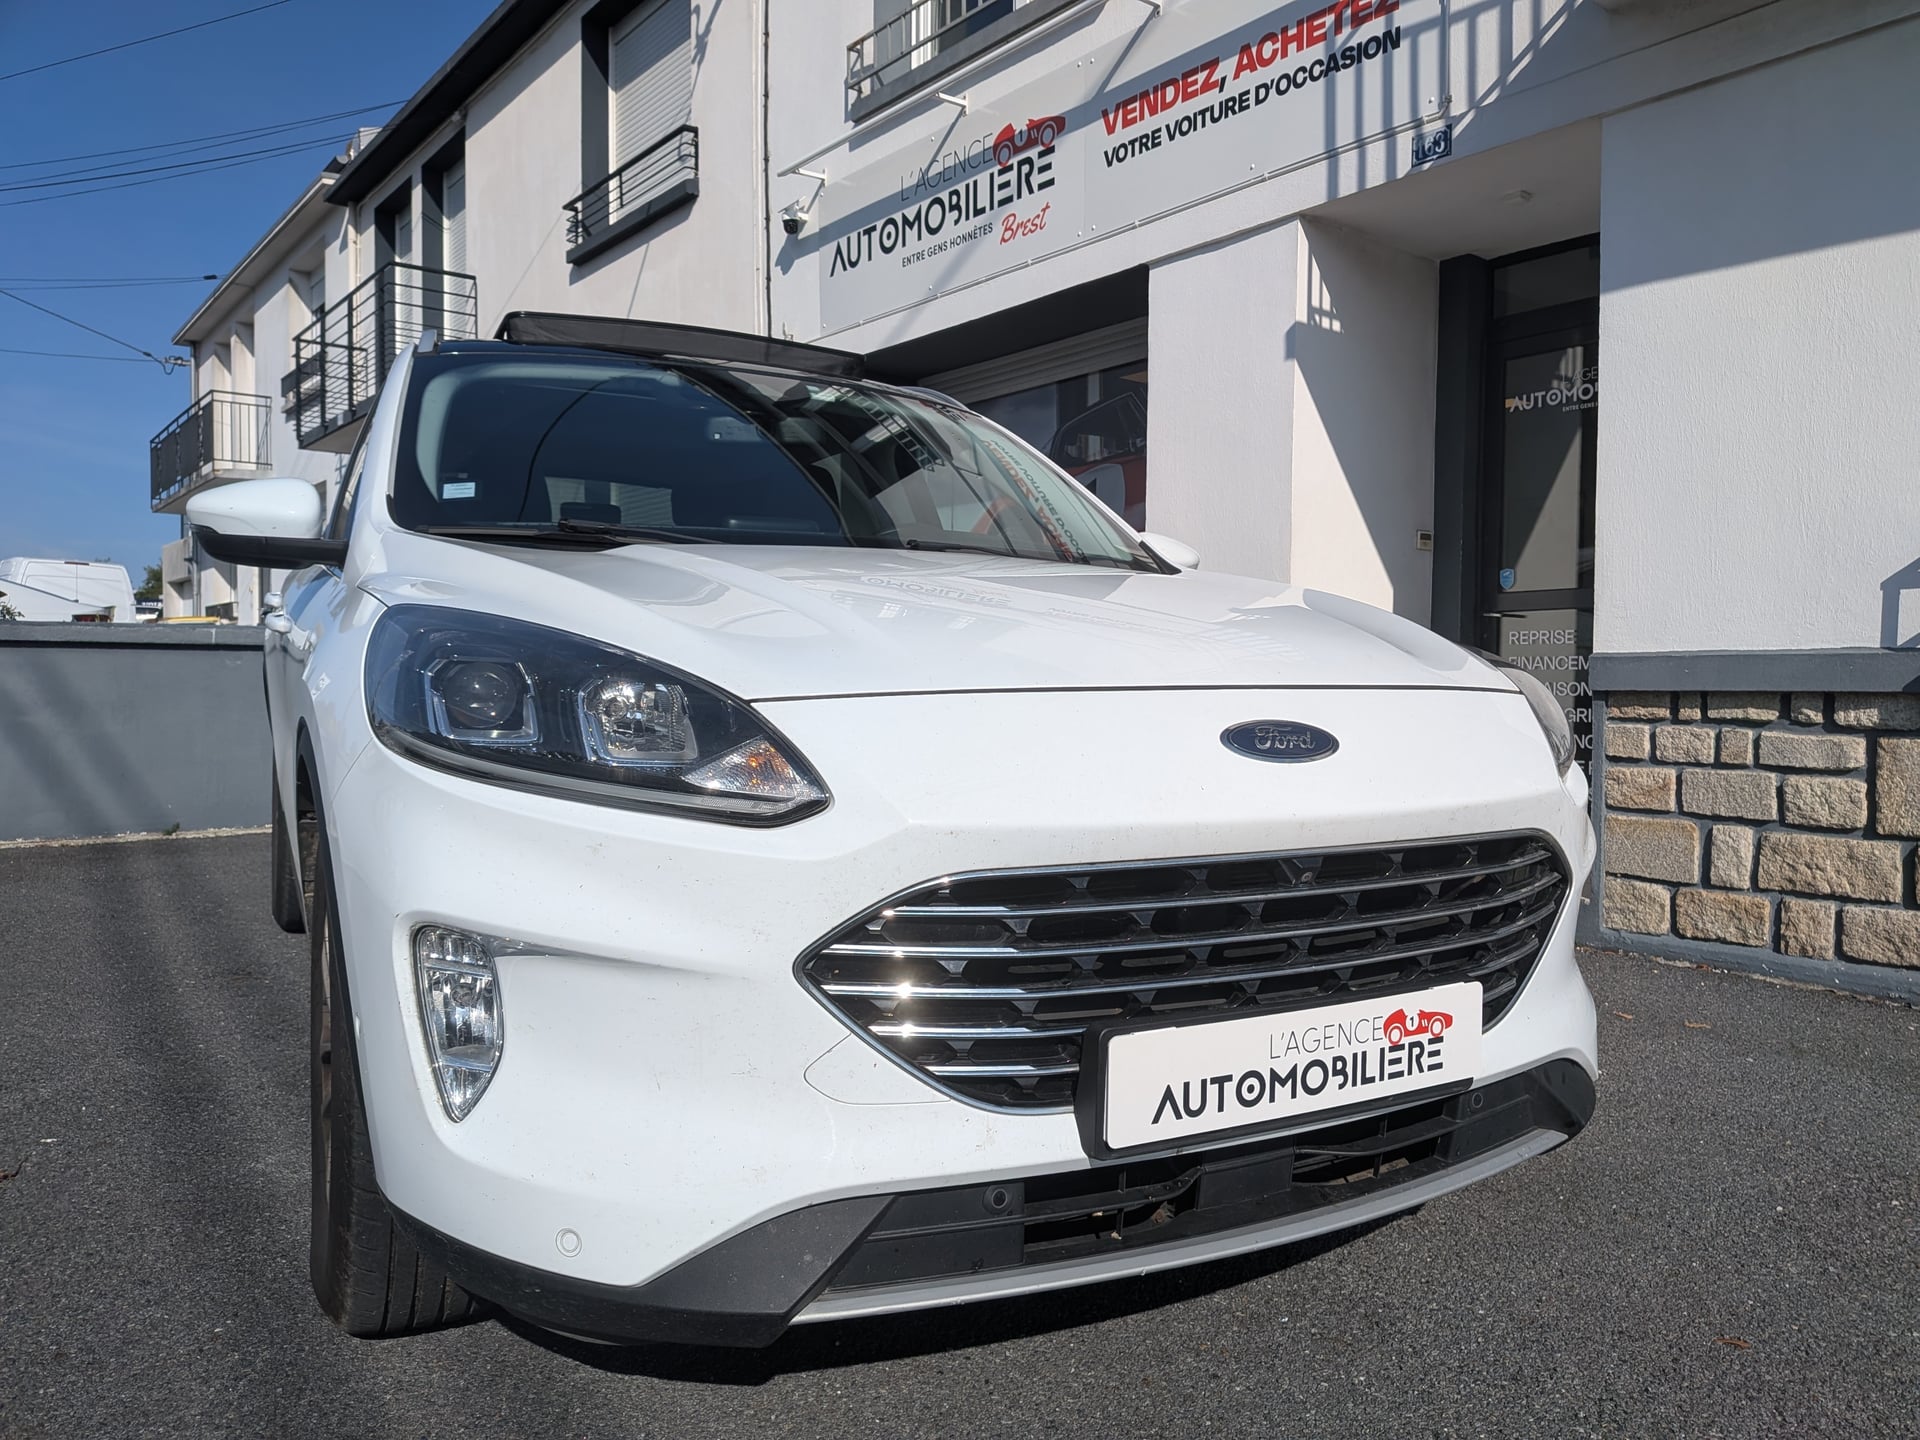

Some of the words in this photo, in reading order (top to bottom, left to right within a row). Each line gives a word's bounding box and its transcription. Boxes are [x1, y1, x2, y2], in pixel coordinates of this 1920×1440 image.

[1101, 56, 1227, 136] VENDEZ,
[1103, 127, 1162, 168] VOTRE
[1165, 90, 1251, 142] VOITURE
[1254, 26, 1401, 107] D'OCCASION
[901, 132, 993, 202] L'AGENCE
[1418, 132, 1446, 159] 163
[902, 250, 926, 268] ENTRE
[927, 241, 948, 258] GENS
[949, 222, 993, 249] HONNÊTES
[1000, 201, 1051, 245] Brest
[1508, 630, 1575, 645] REPRISE
[1255, 726, 1316, 749] Ford
[1269, 1016, 1384, 1060] L'AGENCE
